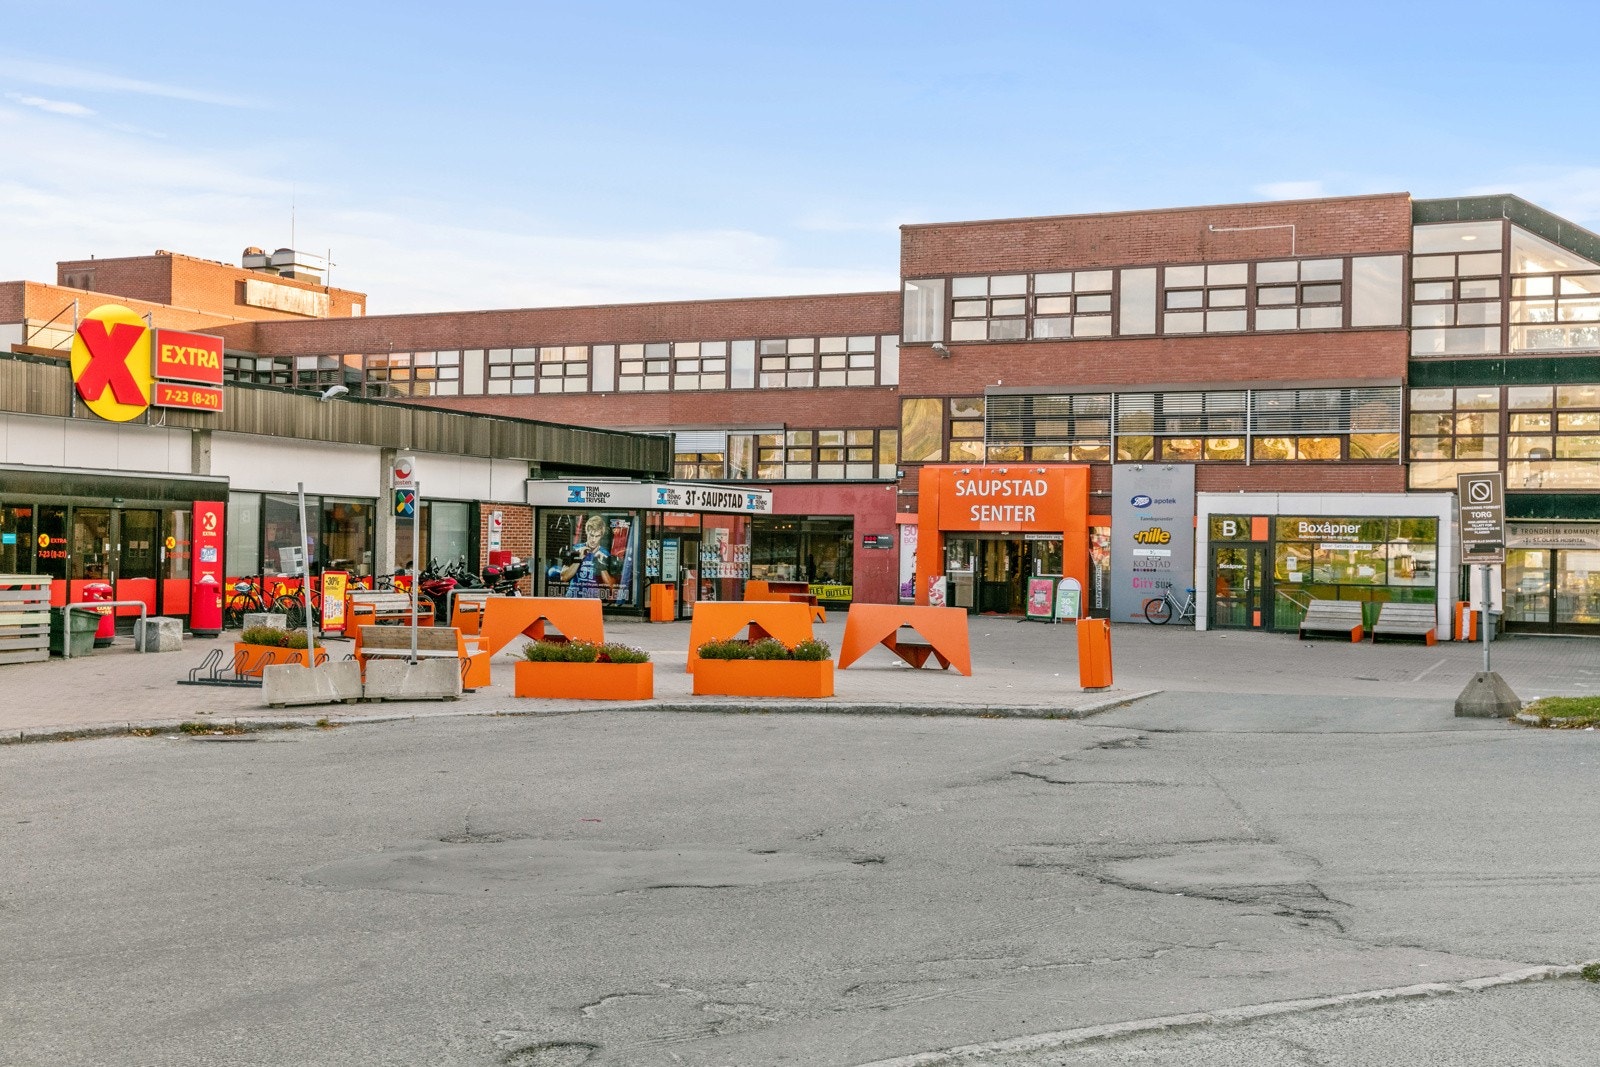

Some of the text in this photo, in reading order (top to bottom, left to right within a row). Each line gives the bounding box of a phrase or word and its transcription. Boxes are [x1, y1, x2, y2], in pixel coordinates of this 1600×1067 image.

[161, 344, 219, 369] EXTRA
[165, 389, 218, 408] 7-23 (8-21)
[955, 479, 1048, 497] SAUPSTAD
[970, 505, 1036, 522] SENTER
[1222, 520, 1237, 536] B
[1298, 521, 1361, 535] Boxåpner
[1133, 560, 1171, 568] KOLSTAD
[825, 587, 851, 598] OUTLET
